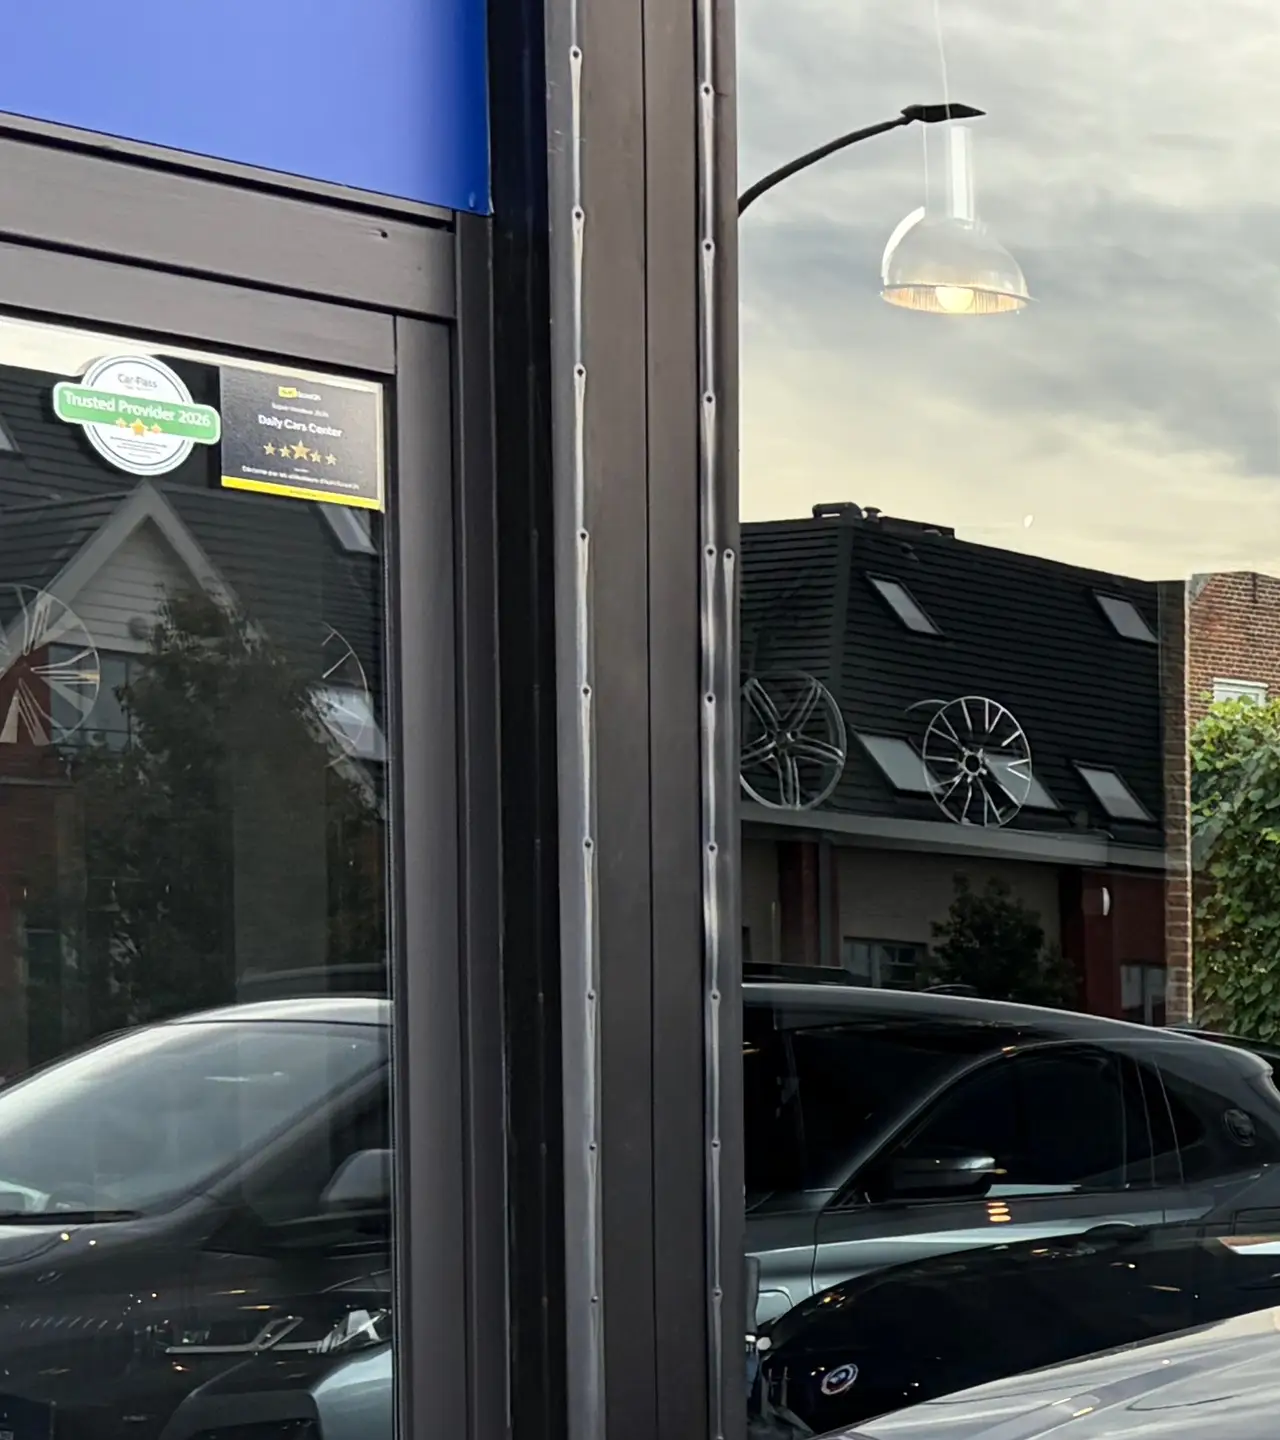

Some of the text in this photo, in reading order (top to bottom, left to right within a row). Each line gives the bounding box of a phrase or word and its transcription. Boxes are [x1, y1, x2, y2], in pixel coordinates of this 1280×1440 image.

[62, 390, 211, 428] Trusted Provider 2026
[257, 414, 344, 437] Daily Cars Center
